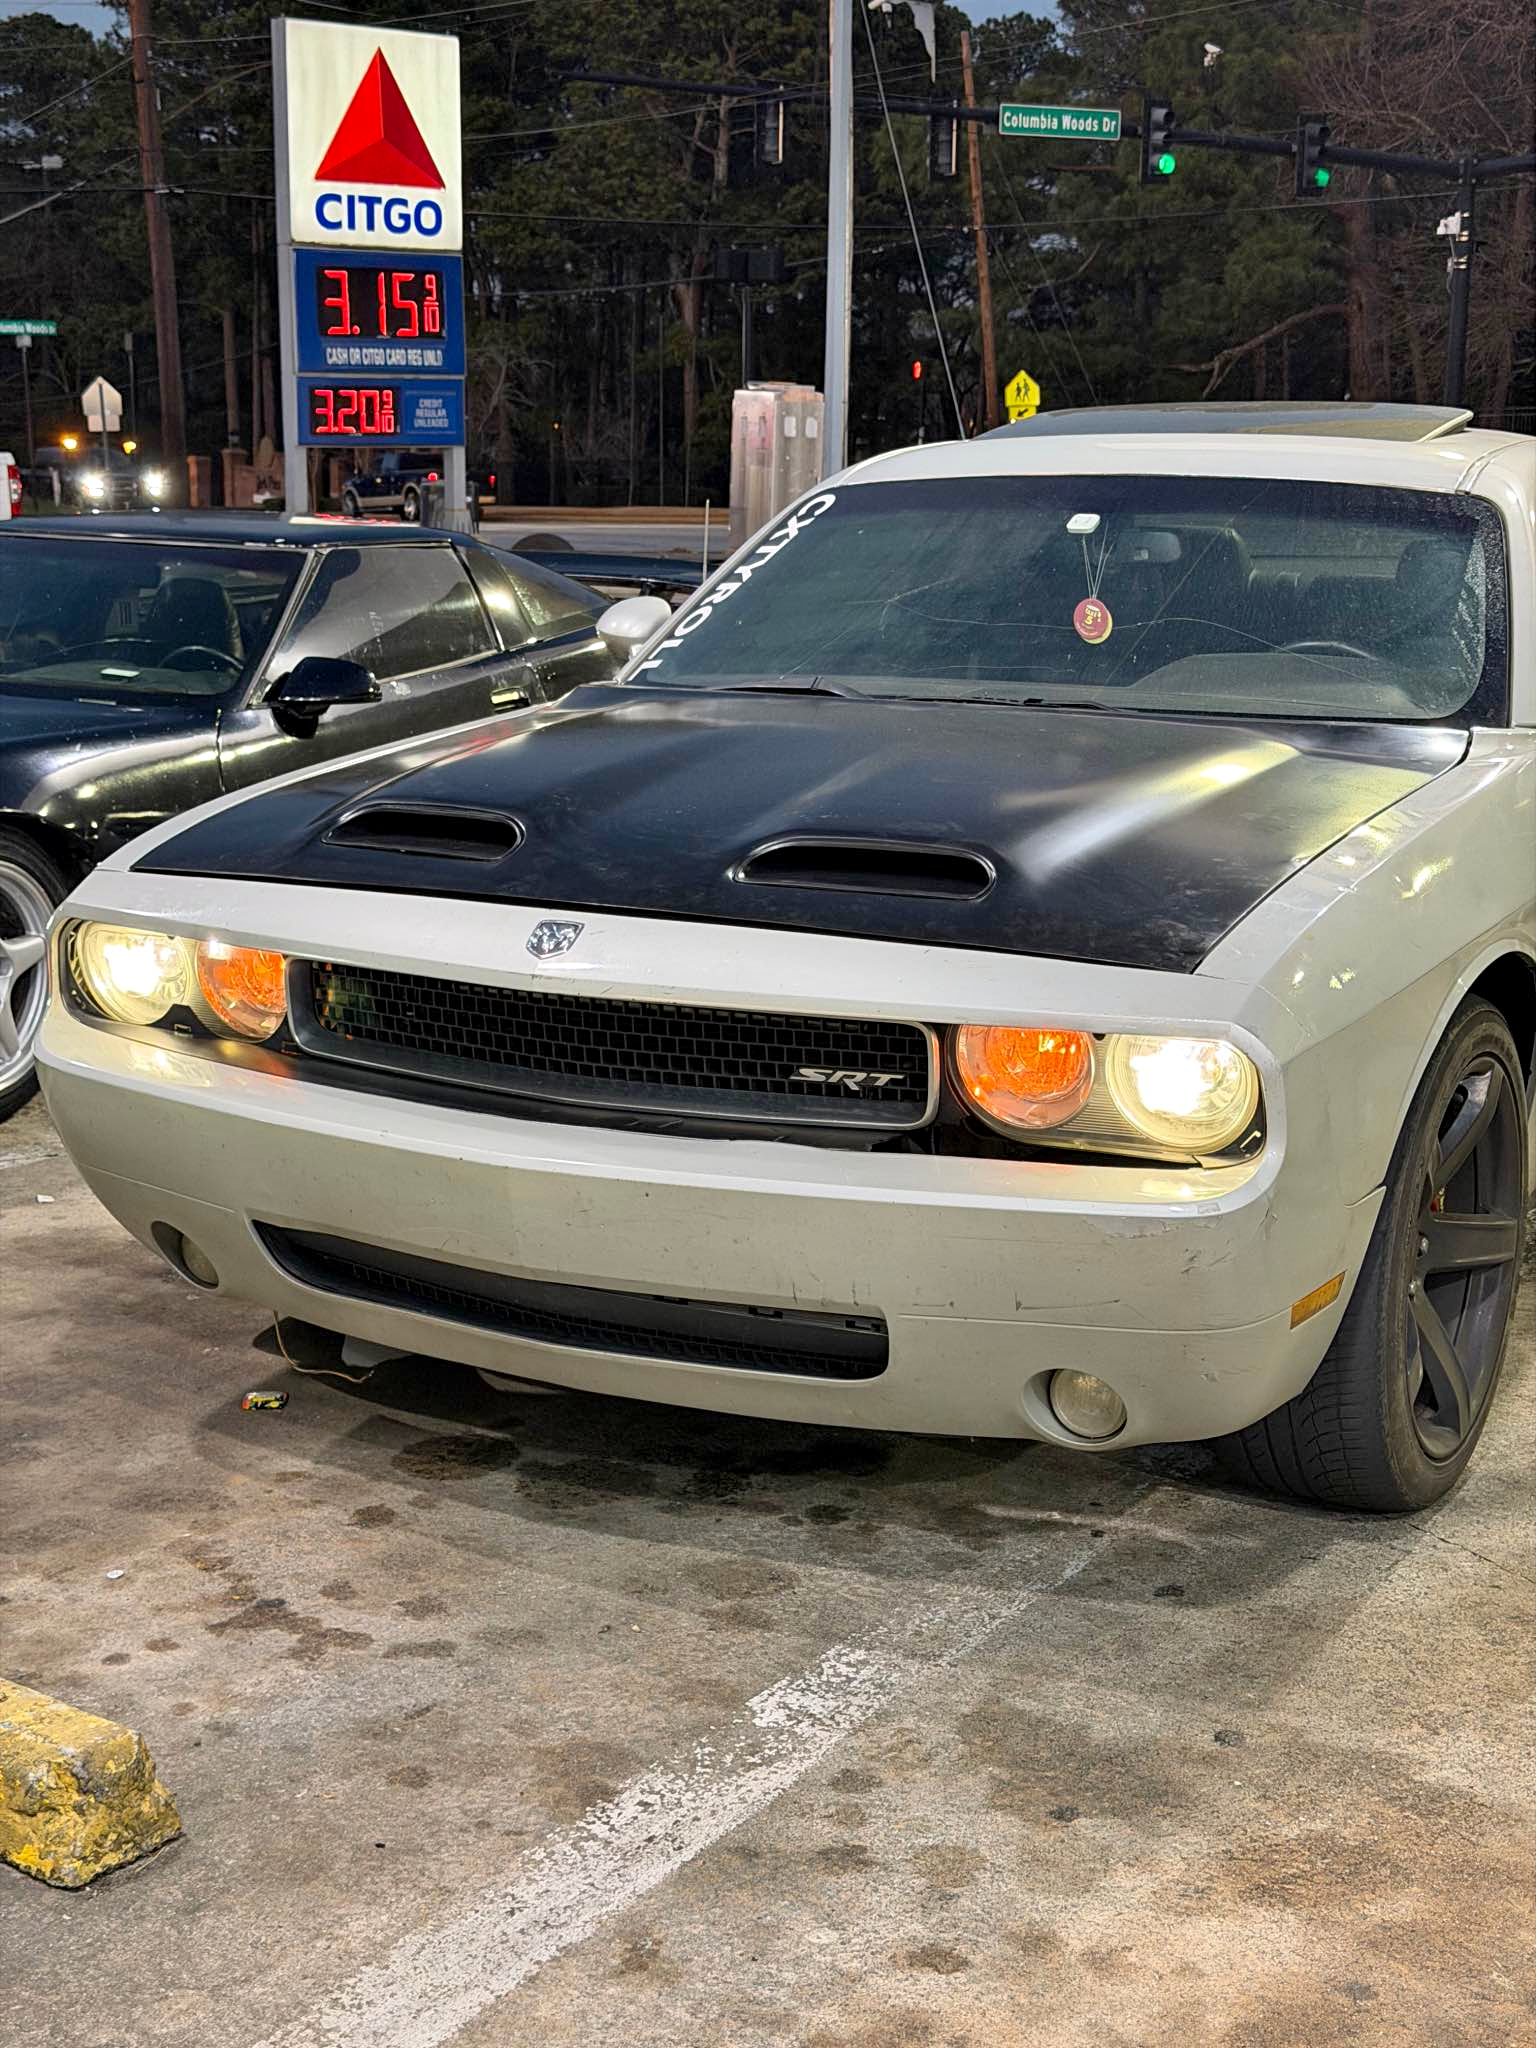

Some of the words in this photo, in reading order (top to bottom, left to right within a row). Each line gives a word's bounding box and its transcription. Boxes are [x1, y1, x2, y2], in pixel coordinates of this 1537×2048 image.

[1003, 112, 1058, 130] Columbia
[1062, 114, 1099, 132] Woods
[1102, 117, 1117, 133] Dr
[315, 193, 442, 236] CITGO
[324, 270, 418, 336] 3.15
[326, 347, 348, 364] CASH
[349, 348, 361, 365] OR
[362, 348, 385, 365] CITGO
[386, 348, 406, 365] CARD
[407, 349, 422, 366] REG
[415, 408, 447, 418] REGULAR
[418, 399, 443, 408] CREDIT
[414, 418, 449, 428] UNLEADED
[789, 1068, 904, 1091] SRT
